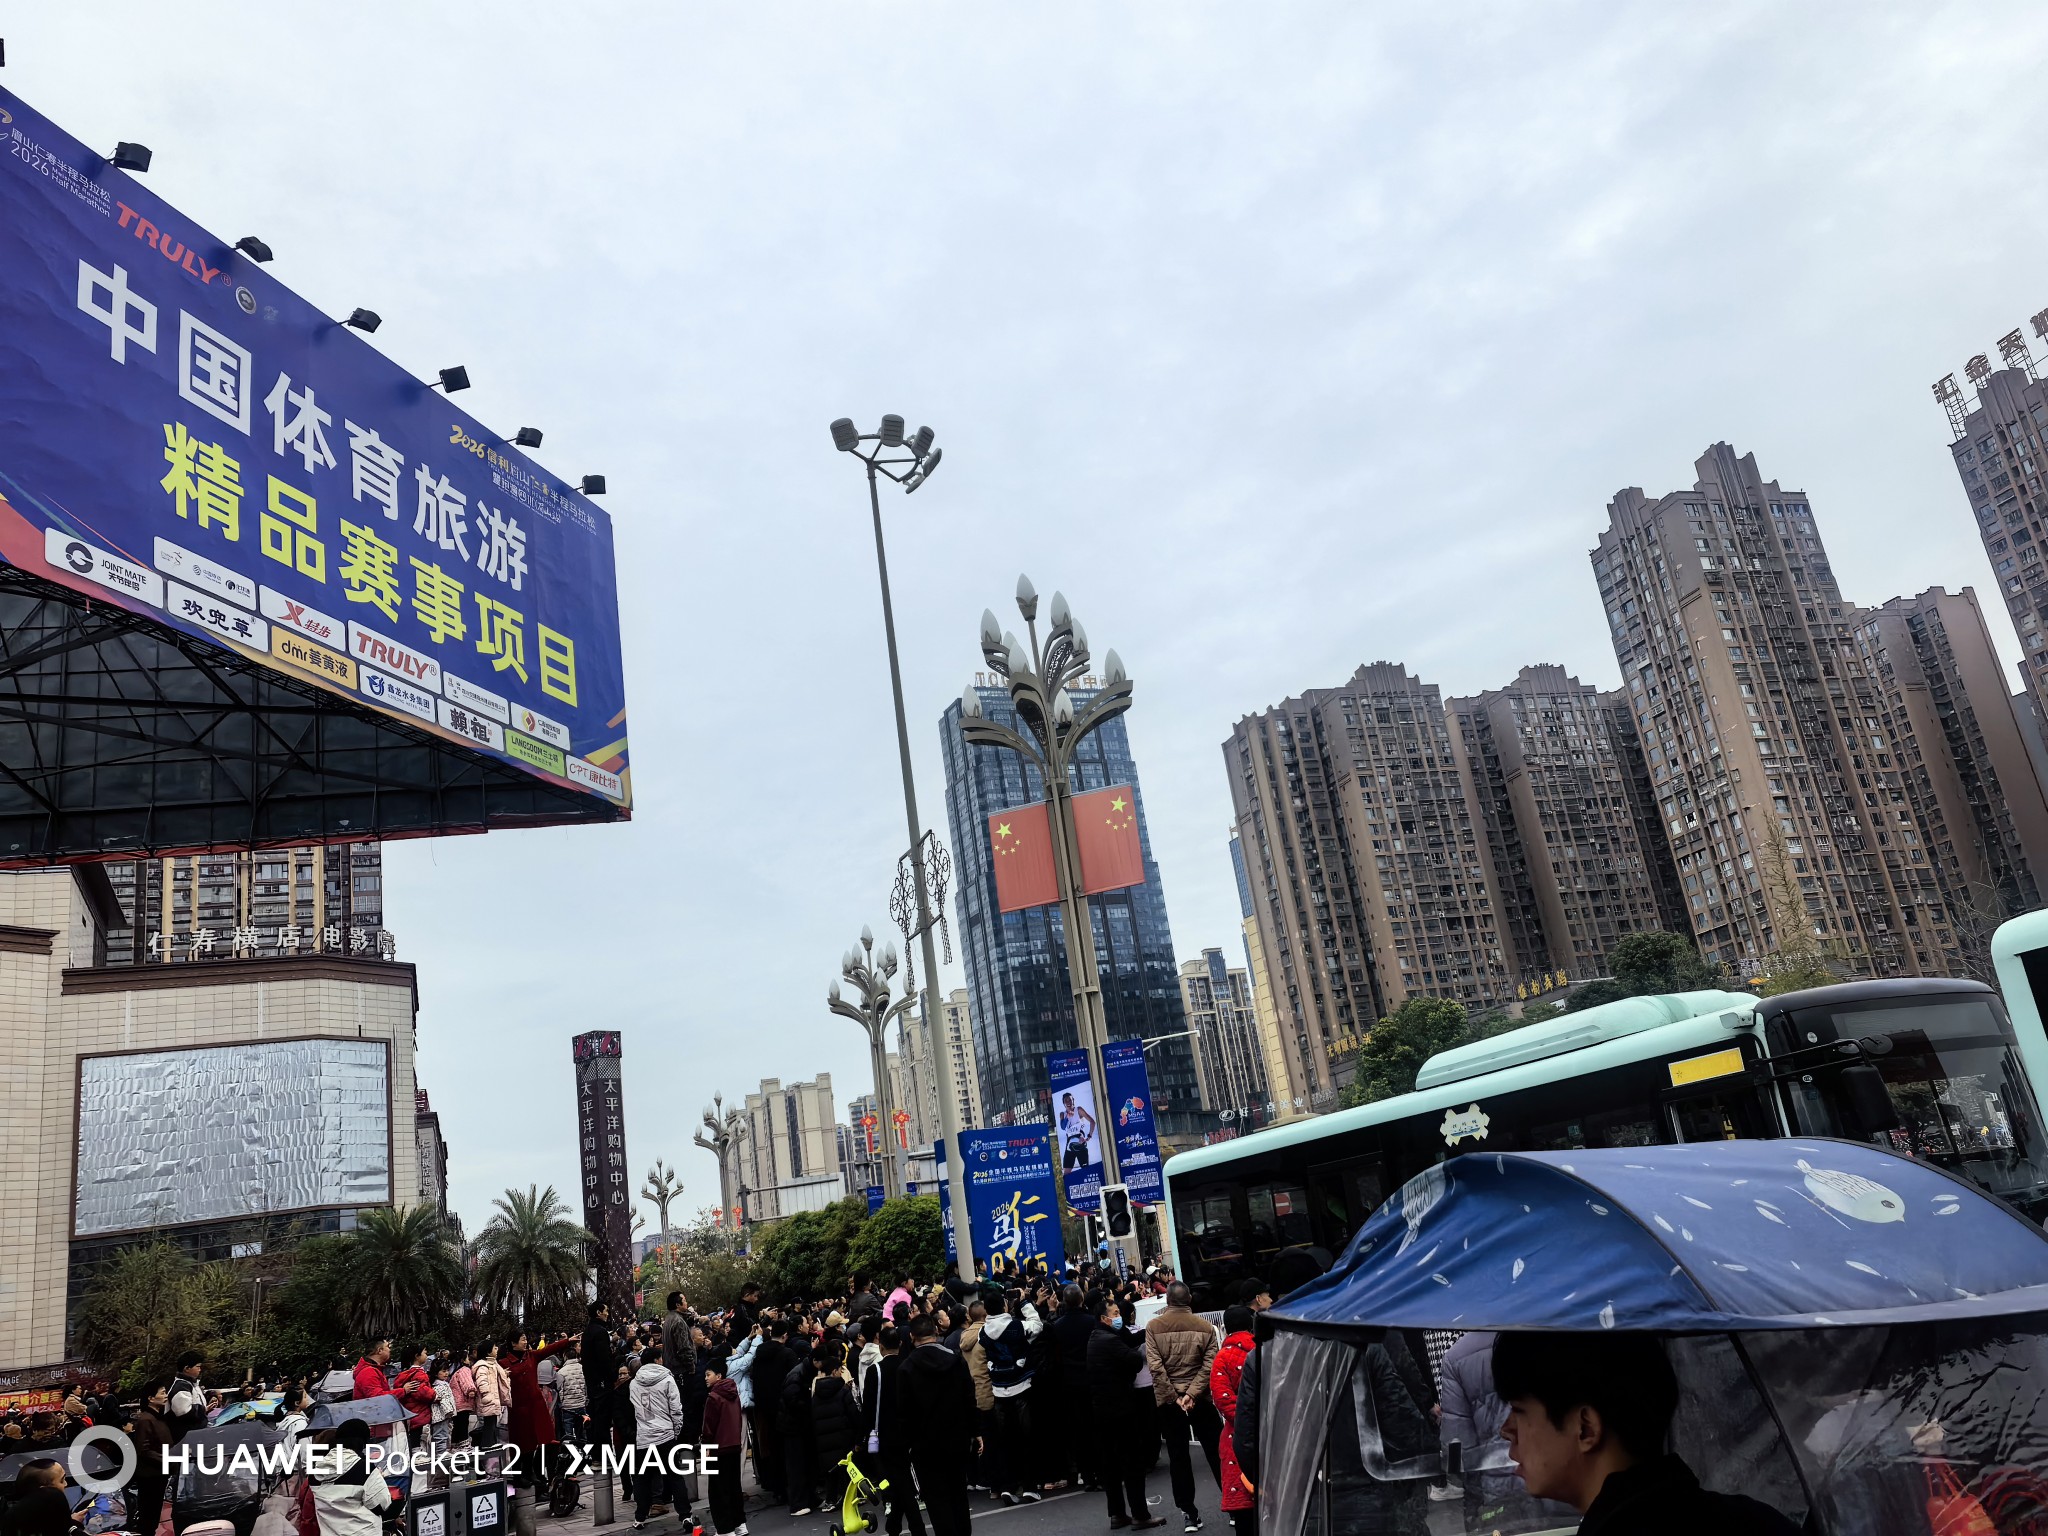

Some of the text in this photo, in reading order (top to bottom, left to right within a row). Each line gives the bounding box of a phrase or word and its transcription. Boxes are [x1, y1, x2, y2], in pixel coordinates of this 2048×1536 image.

[11, 140, 49, 176] 2026
[11, 127, 110, 203] 眉山仁寿半程马拉松
[52, 173, 110, 217] Half Marathon
[116, 201, 220, 285] TRULY
[77, 258, 528, 591] 中国体育旅游
[450, 425, 486, 459] 2026
[101, 558, 147, 585] JOINT MATE
[160, 421, 578, 709] 精品赛事项目
[182, 599, 252, 639] 欢兜草
[304, 618, 331, 639] 特步
[309, 647, 348, 679] 姜黄液
[356, 631, 429, 680] TRULY
[589, 770, 618, 791] 康比特
[148, 924, 397, 955] 仁寿横店电影院
[580, 1082, 599, 1209] 太平洋购物中心
[604, 1079, 624, 1206] 太平洋购物中心
[992, 1201, 1010, 1220] 2026
